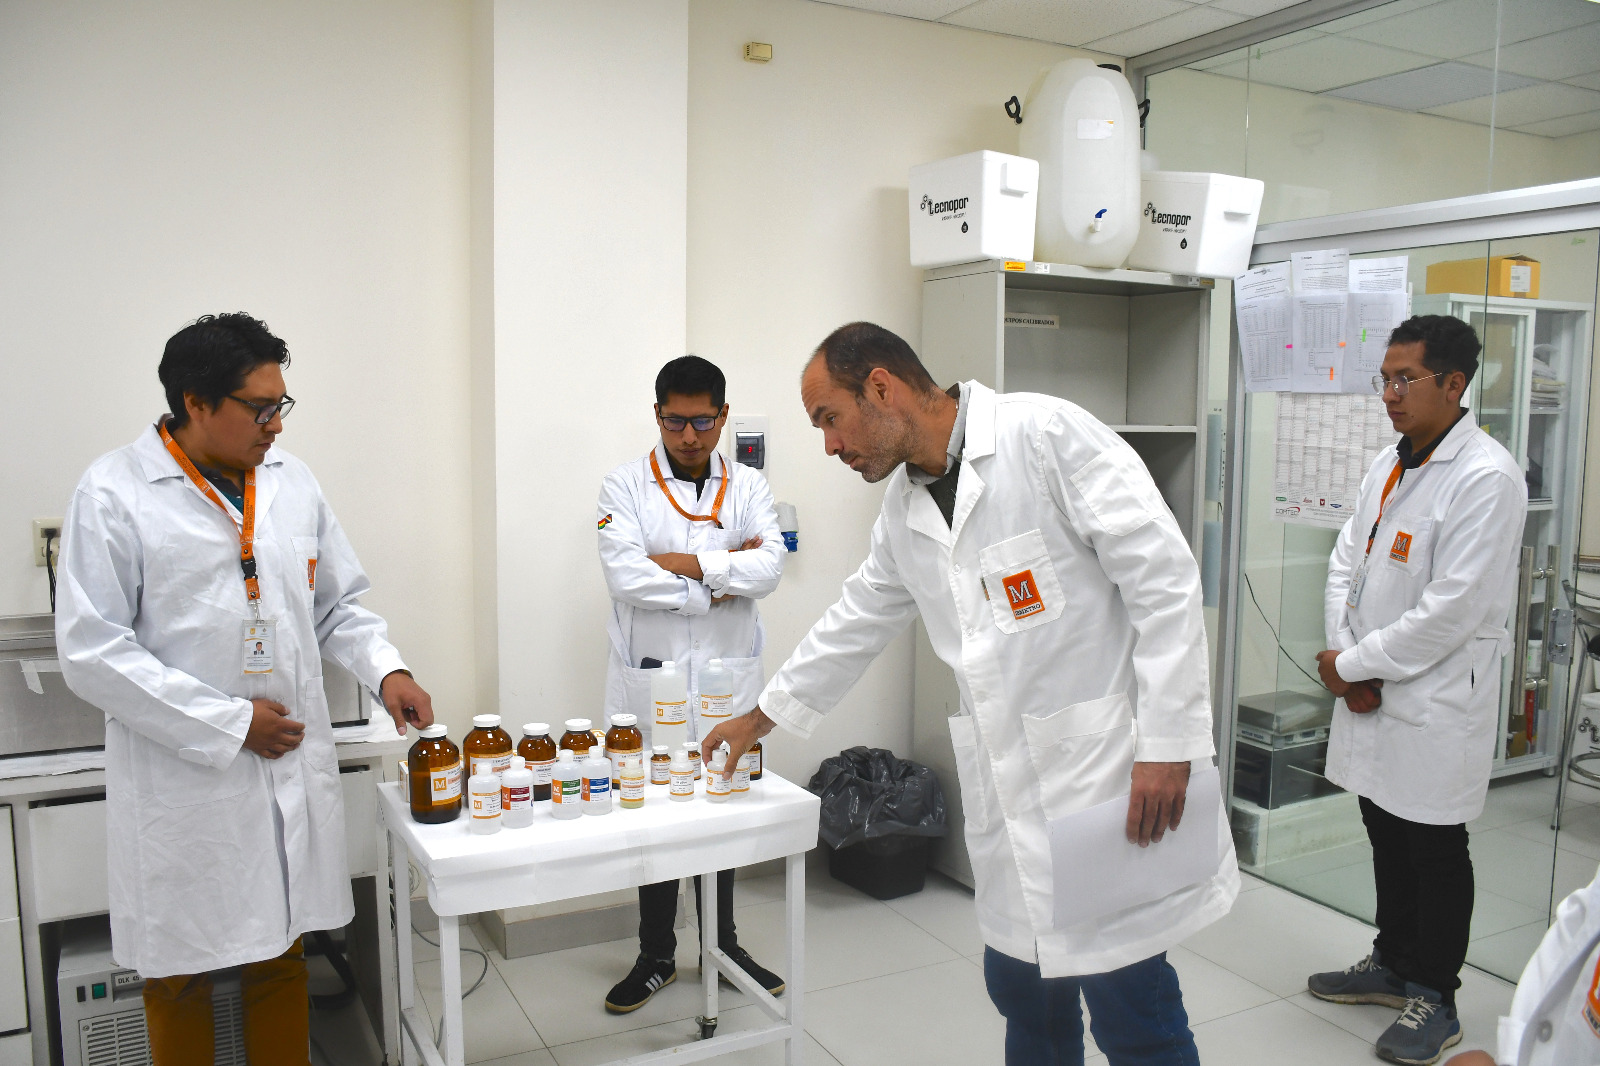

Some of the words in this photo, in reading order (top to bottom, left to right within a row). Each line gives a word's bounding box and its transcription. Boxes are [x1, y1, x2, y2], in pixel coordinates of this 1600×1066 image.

[928, 197, 969, 216] tecnopor
[1151, 207, 1192, 228] tecnopor
[1023, 318, 1055, 326] CALIBRADOS
[1394, 535, 1409, 553] M
[1008, 580, 1033, 603] M
[435, 779, 446, 790] M
